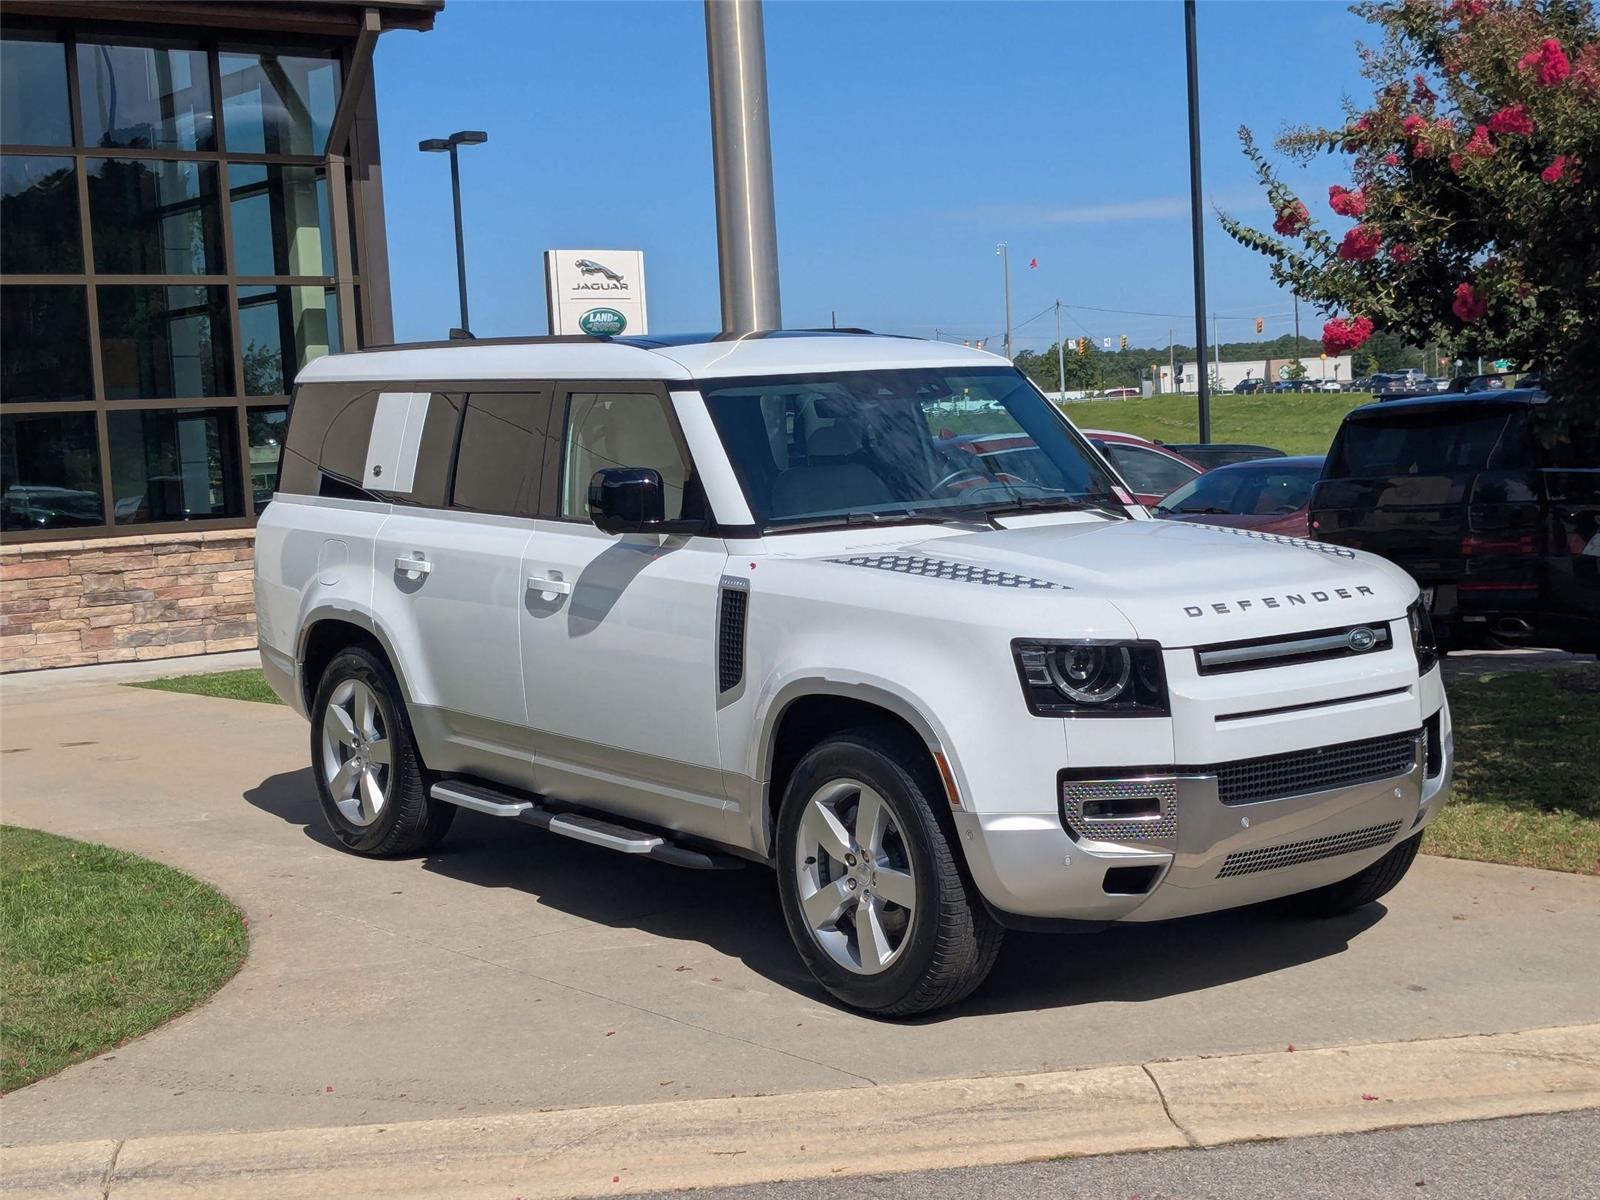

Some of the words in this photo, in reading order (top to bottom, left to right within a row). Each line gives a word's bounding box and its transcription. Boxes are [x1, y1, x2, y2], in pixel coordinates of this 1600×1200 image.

[572, 283, 629, 291] JAGUAR
[589, 313, 614, 322] LAND
[1183, 585, 1375, 618] DEFENDER
